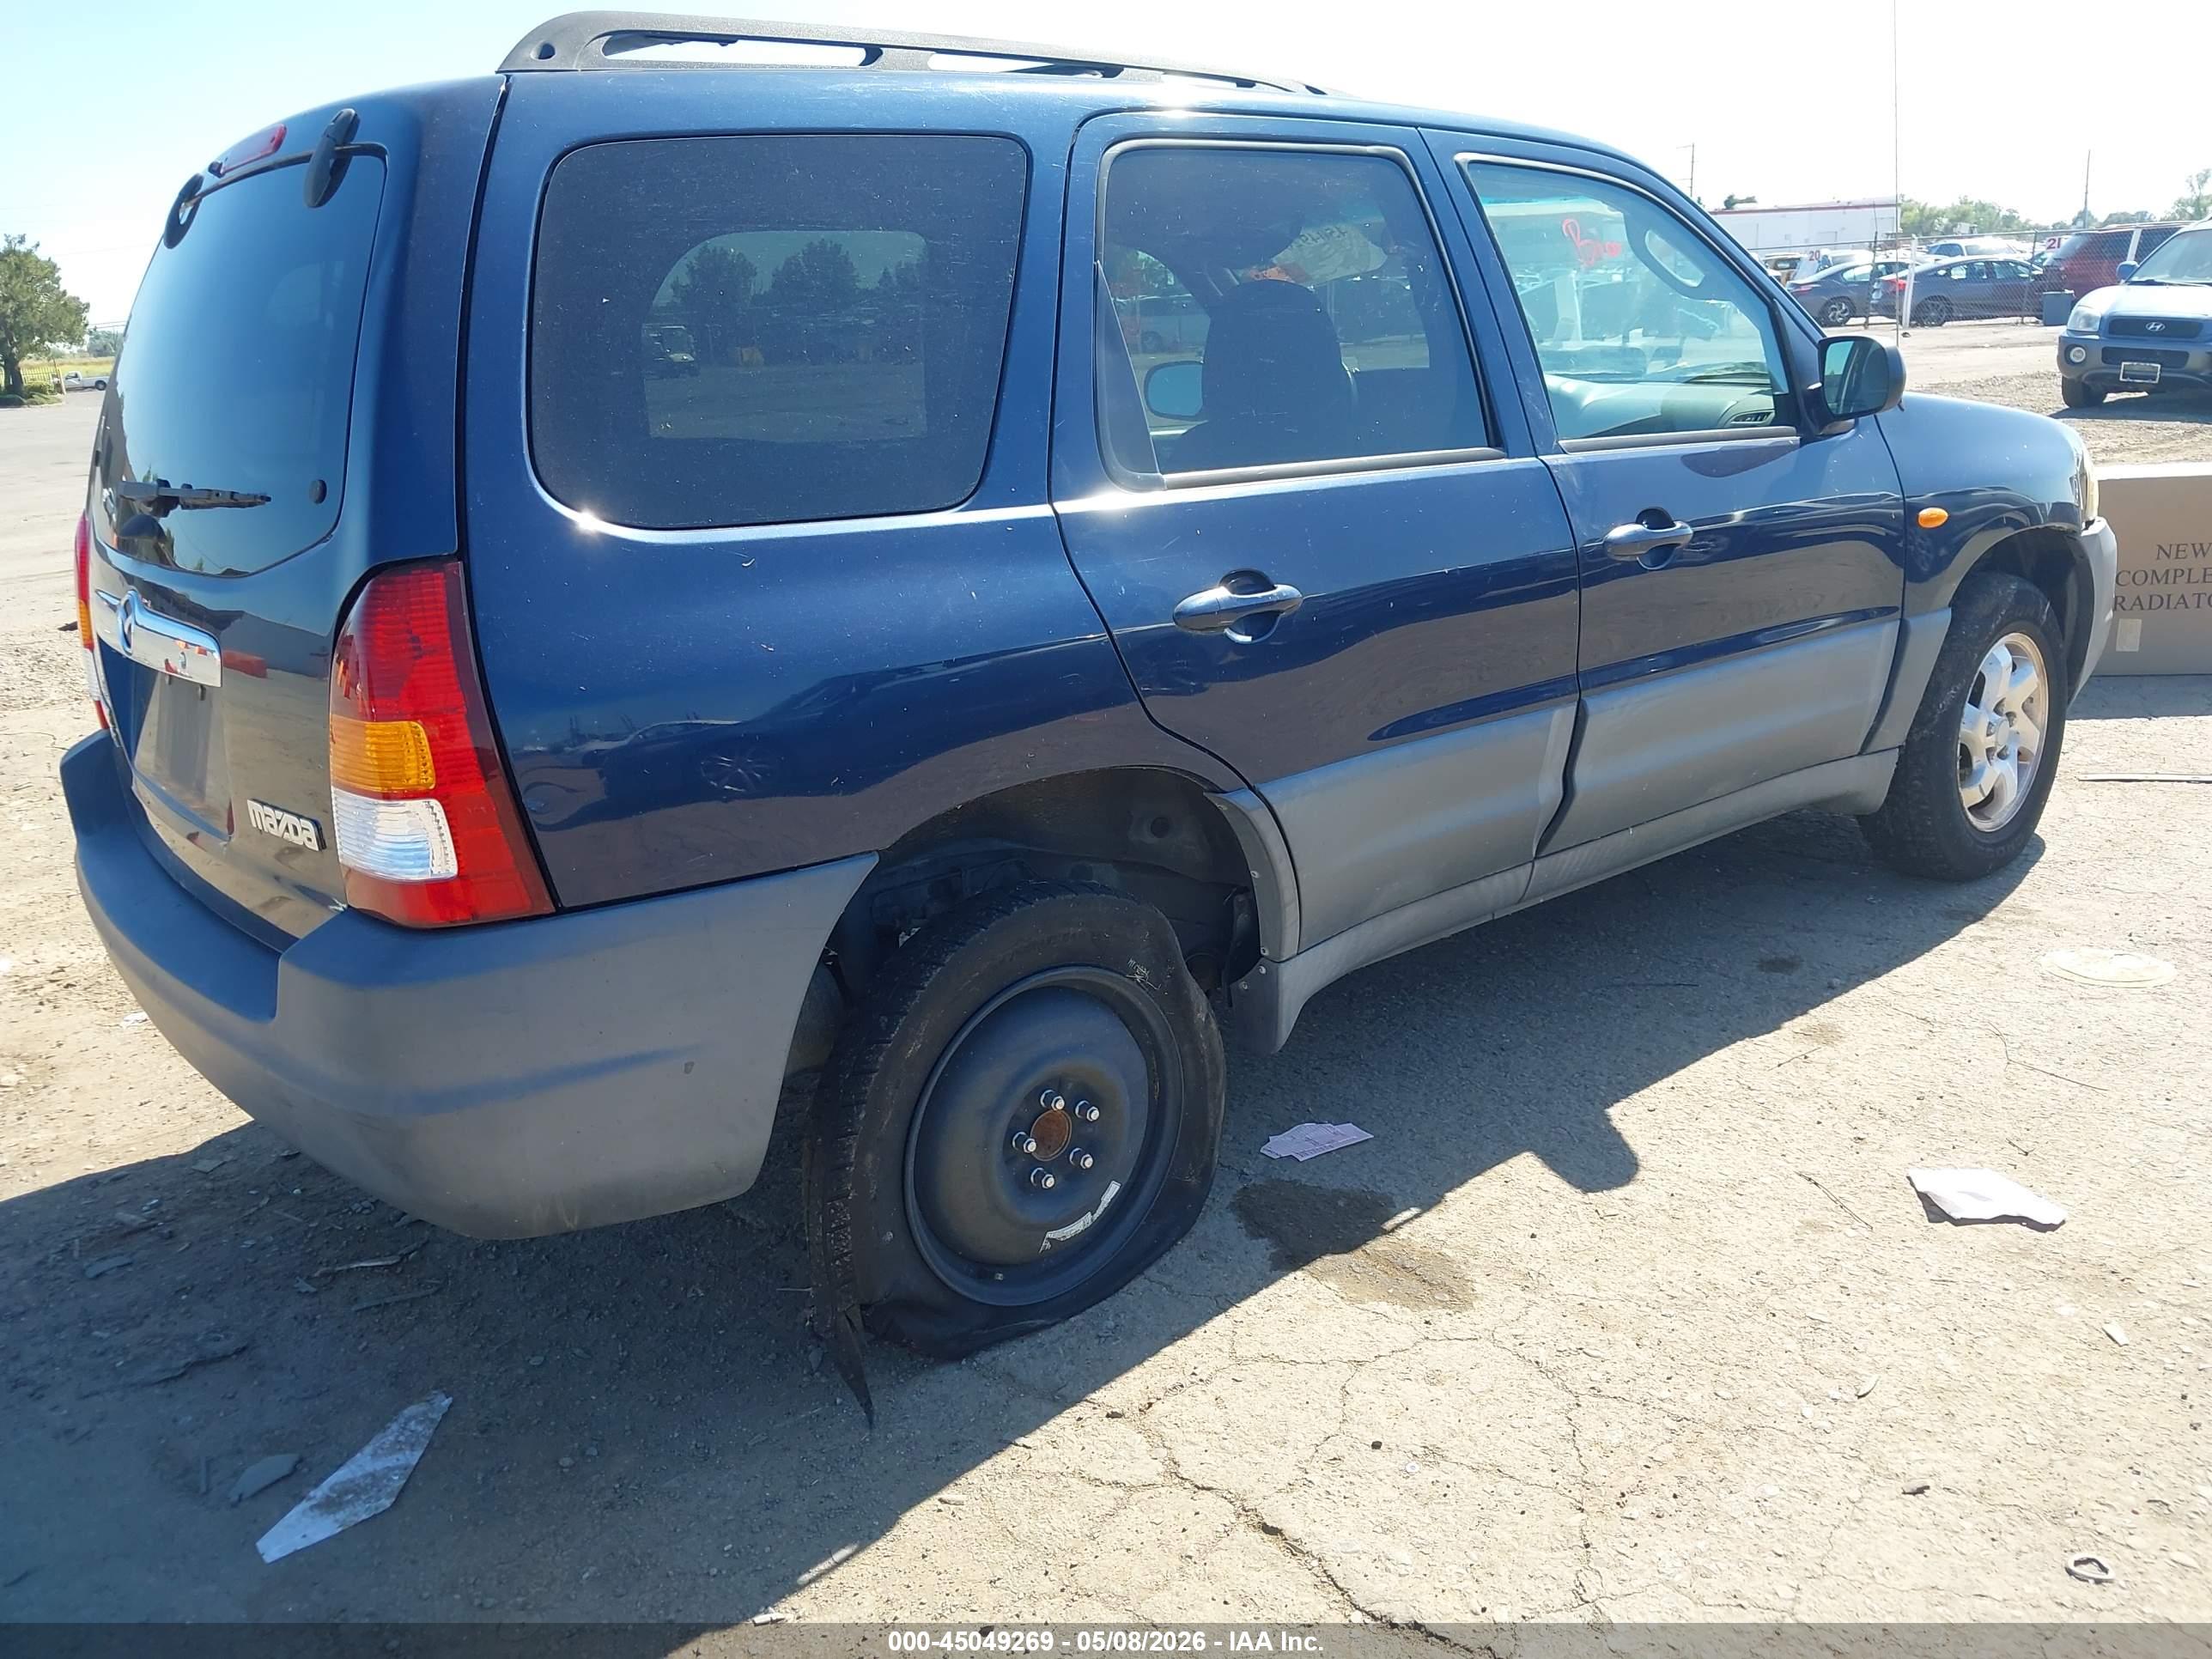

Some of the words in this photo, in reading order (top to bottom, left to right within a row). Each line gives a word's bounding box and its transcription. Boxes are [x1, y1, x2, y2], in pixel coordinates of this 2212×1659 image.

[2046, 237, 2062, 249] 21
[1808, 250, 1820, 261] 20
[2156, 542, 2212, 560] NEW
